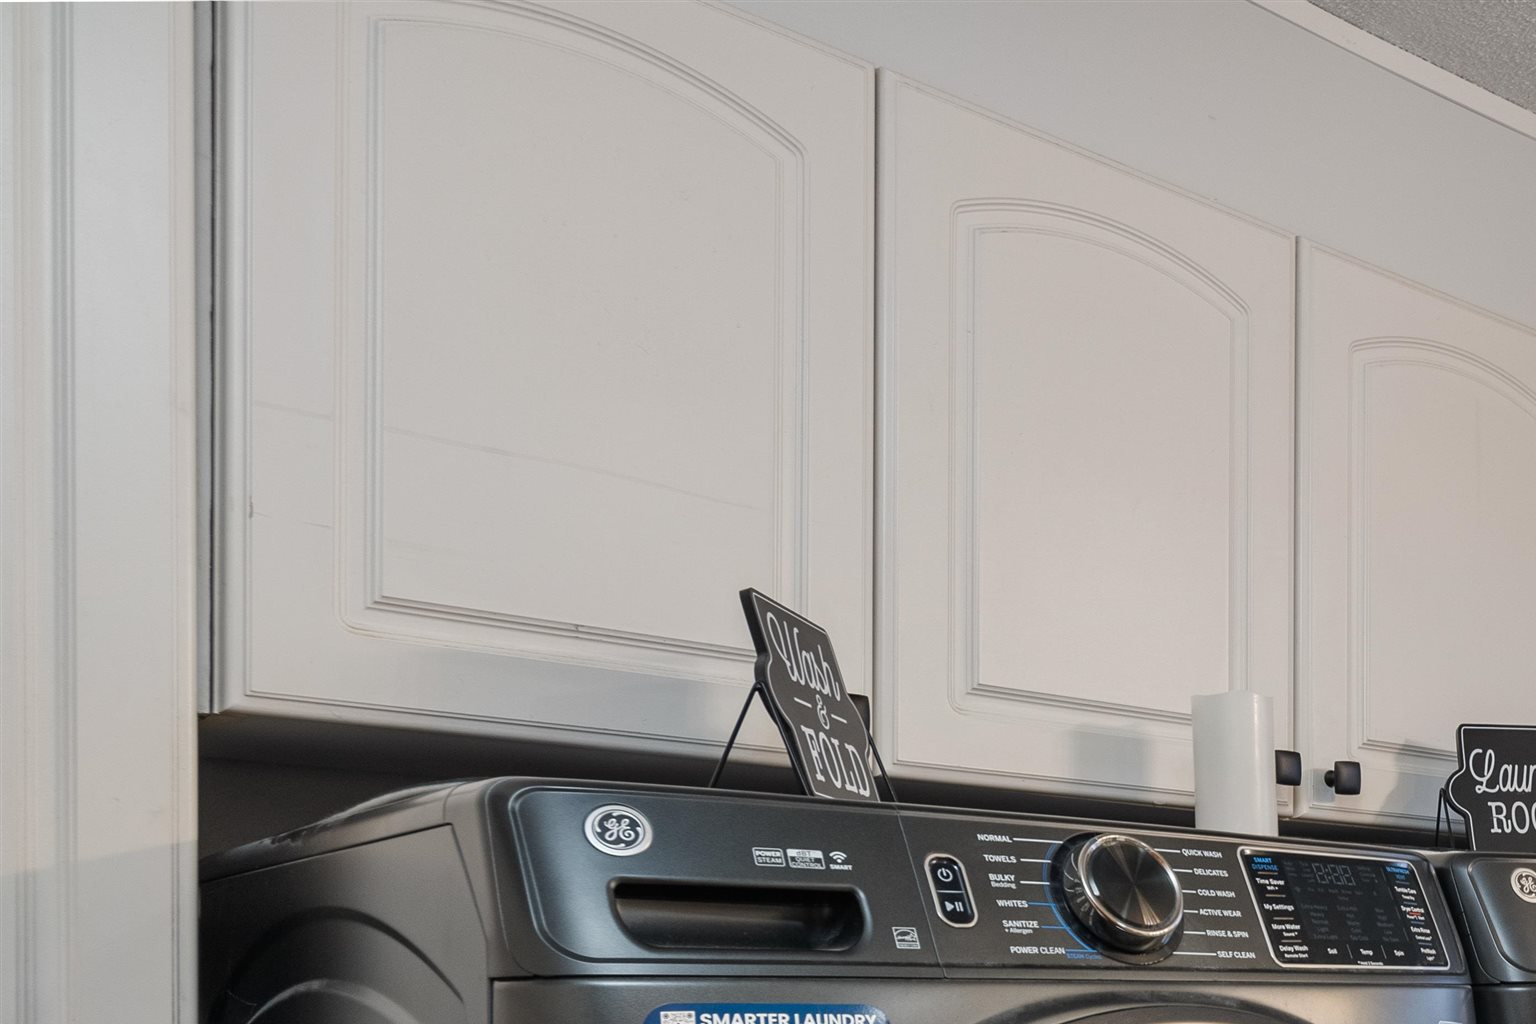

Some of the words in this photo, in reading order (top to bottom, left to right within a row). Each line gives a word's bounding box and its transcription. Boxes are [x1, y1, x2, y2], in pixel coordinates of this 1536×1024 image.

[767, 611, 840, 700] Wash
[816, 695, 830, 730] &
[801, 725, 870, 798] FOLD
[977, 834, 1013, 843] NORMAL
[1182, 848, 1203, 857] QUICK
[1203, 850, 1222, 858] WASH
[983, 854, 1017, 863] TOWELS
[988, 873, 1015, 881] BULKY
[1193, 868, 1229, 877] DELICATES
[990, 881, 1016, 889] Bedding
[1197, 889, 1215, 897] COLD
[1216, 890, 1236, 898] WASH
[996, 899, 1028, 908] WHITES
[1200, 909, 1222, 917] ACTIVE
[1222, 910, 1242, 918] WEAR
[1002, 920, 1040, 928] SANITIZE
[1206, 929, 1226, 938] RINSE
[1233, 930, 1249, 938] SPIN
[1010, 946, 1039, 954] POWER
[1040, 946, 1066, 955] CLEAN
[1234, 951, 1256, 959] CLEAN
